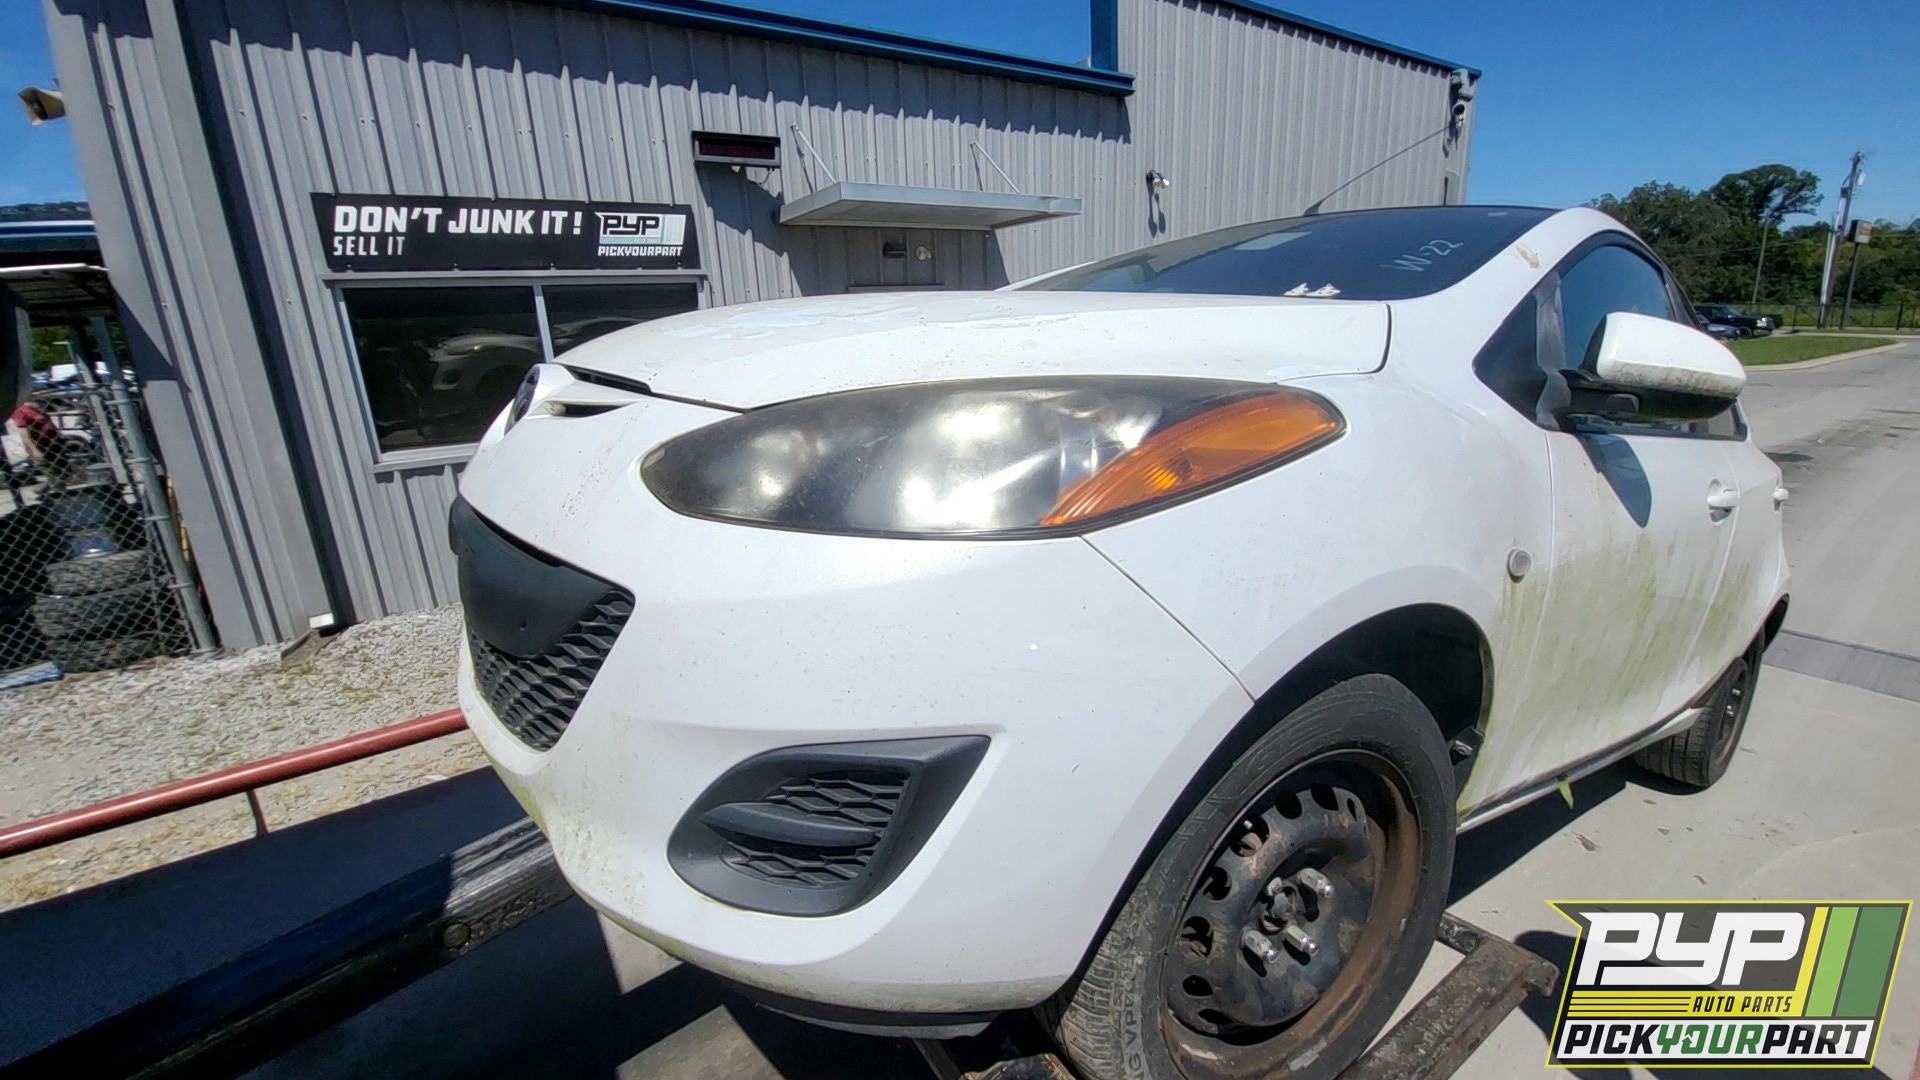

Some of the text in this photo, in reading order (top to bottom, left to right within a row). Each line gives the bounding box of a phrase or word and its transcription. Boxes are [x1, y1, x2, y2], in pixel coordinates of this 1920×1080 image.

[334, 206, 442, 233] DON'T
[448, 208, 535, 234] JUNK
[602, 215, 660, 235] PYP
[333, 236, 406, 256] SELL IT
[598, 246, 682, 257] PICKYOURPART
